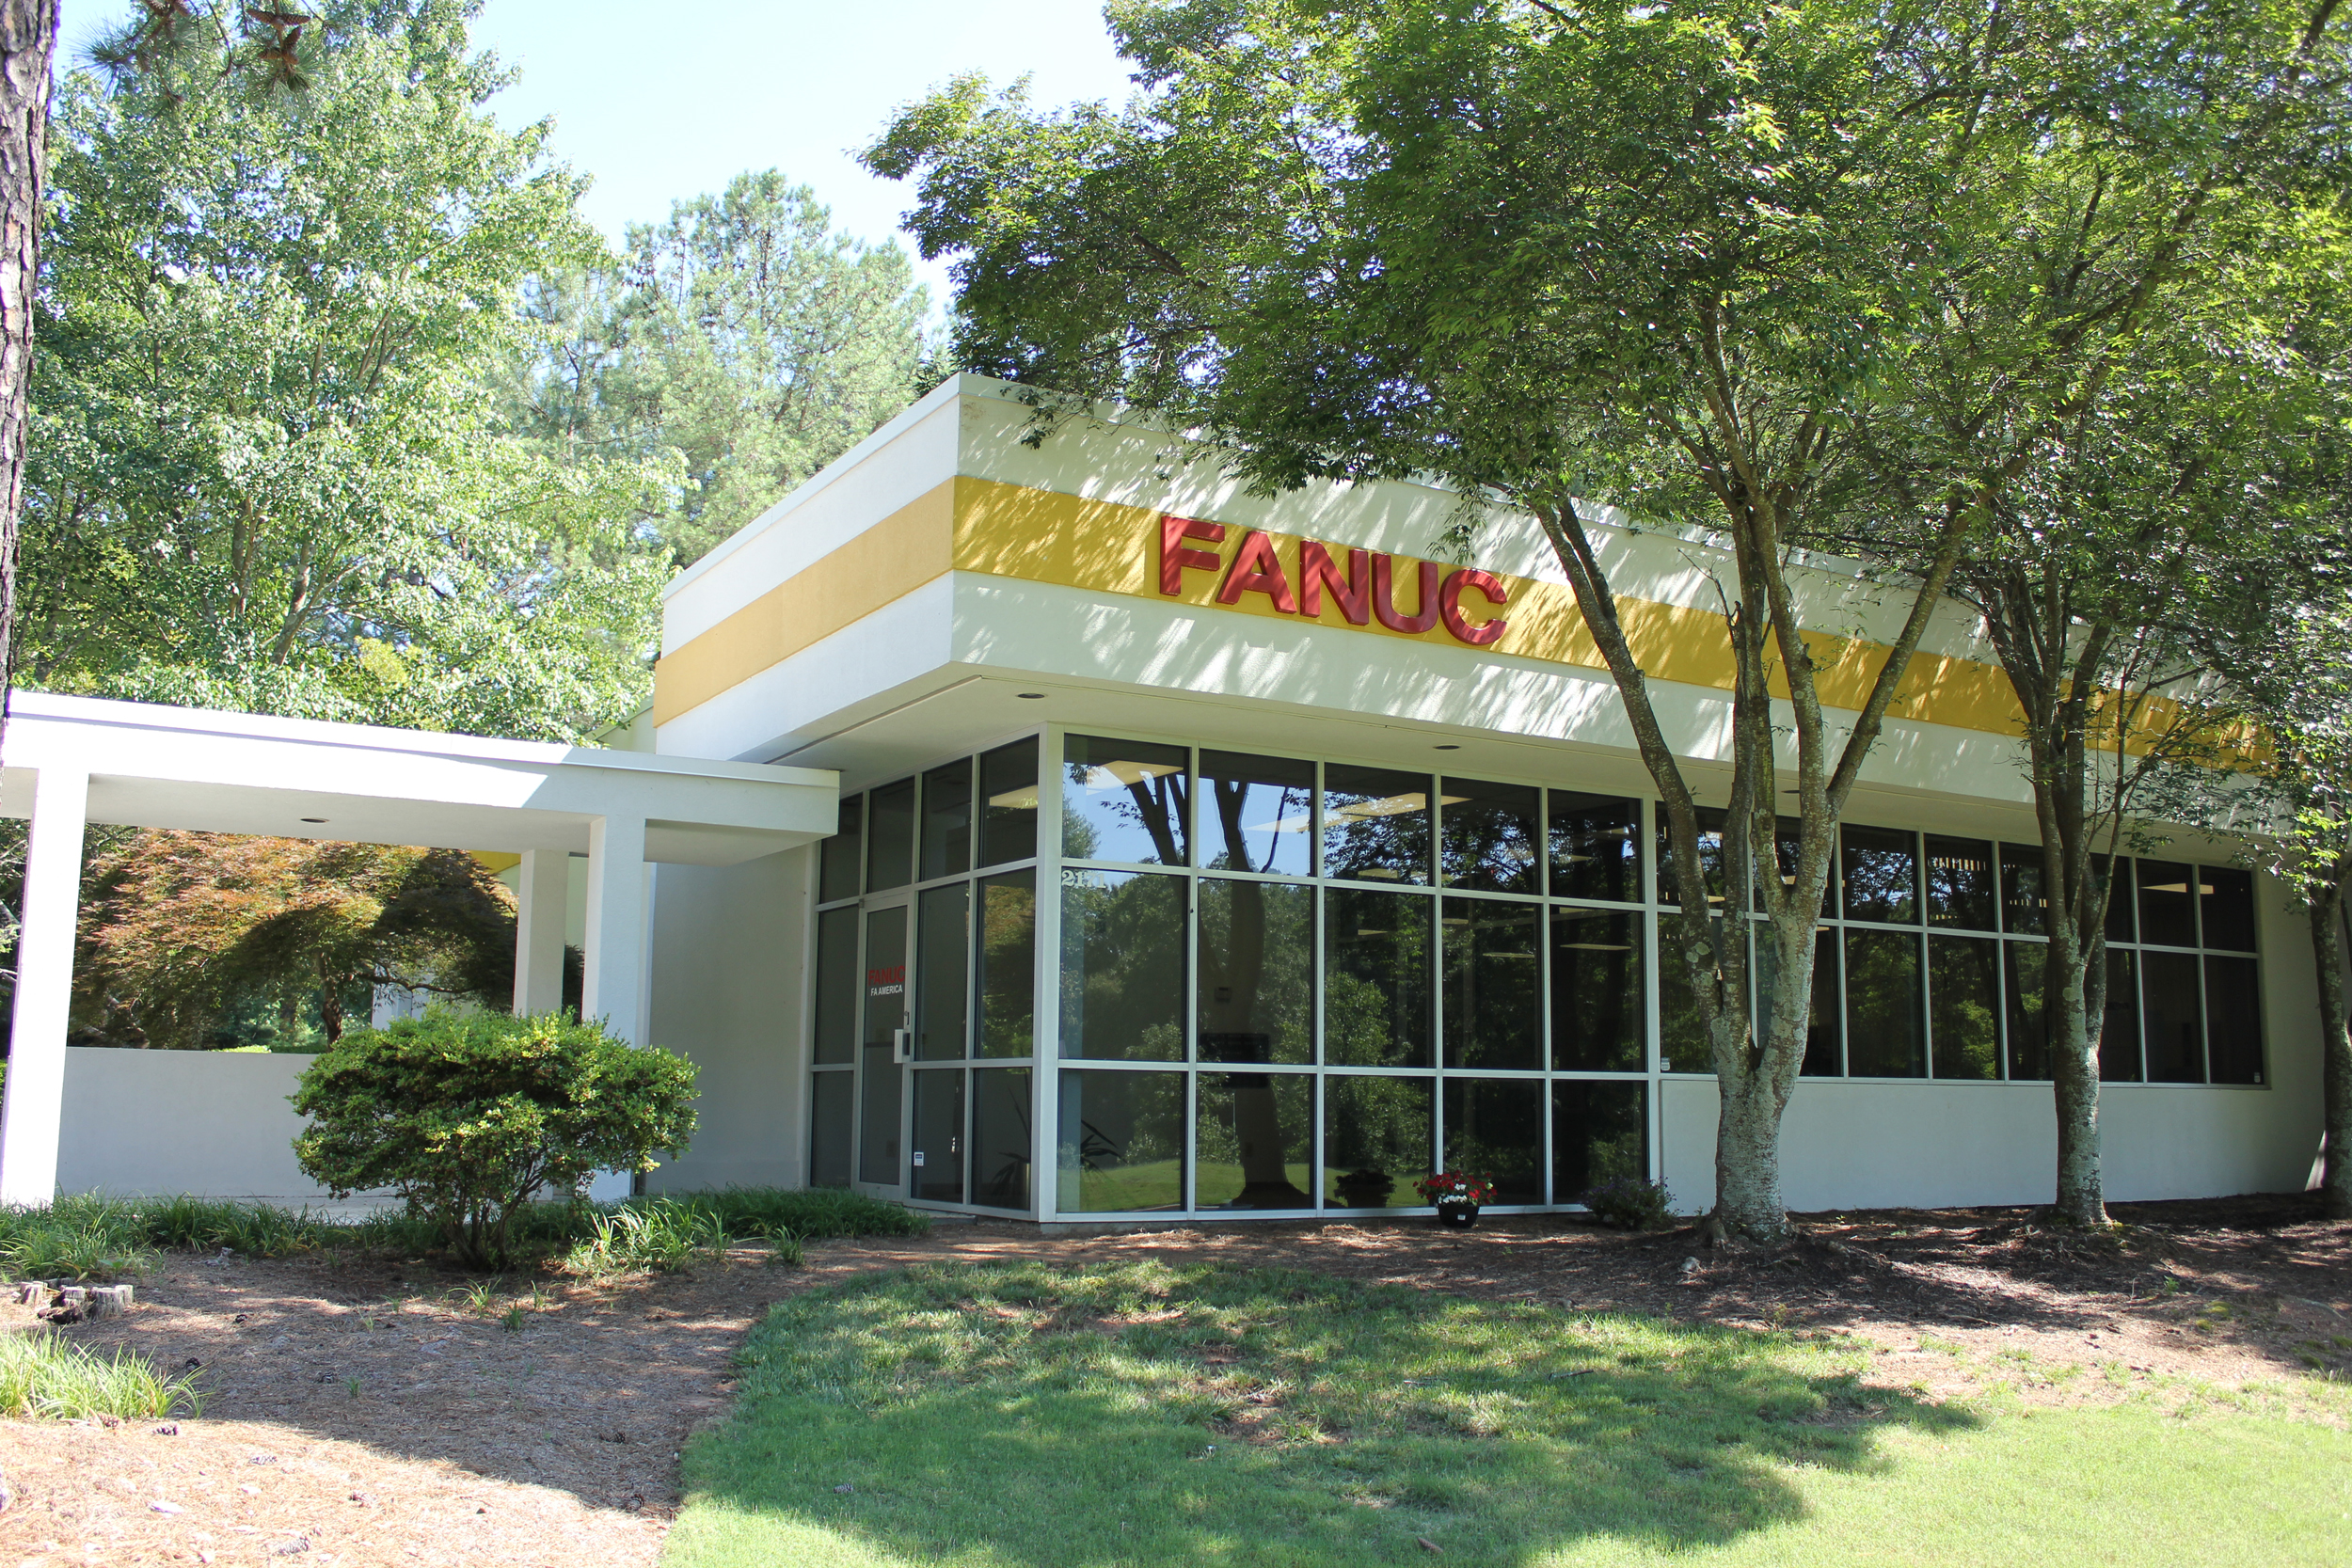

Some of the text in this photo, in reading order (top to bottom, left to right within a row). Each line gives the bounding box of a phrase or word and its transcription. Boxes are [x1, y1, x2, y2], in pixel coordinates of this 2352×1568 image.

[1159, 515, 1507, 646] FANUC
[1061, 869, 1106, 889] 2171
[867, 965, 906, 987] FANUC
[870, 984, 903, 996] FA AMERICA
